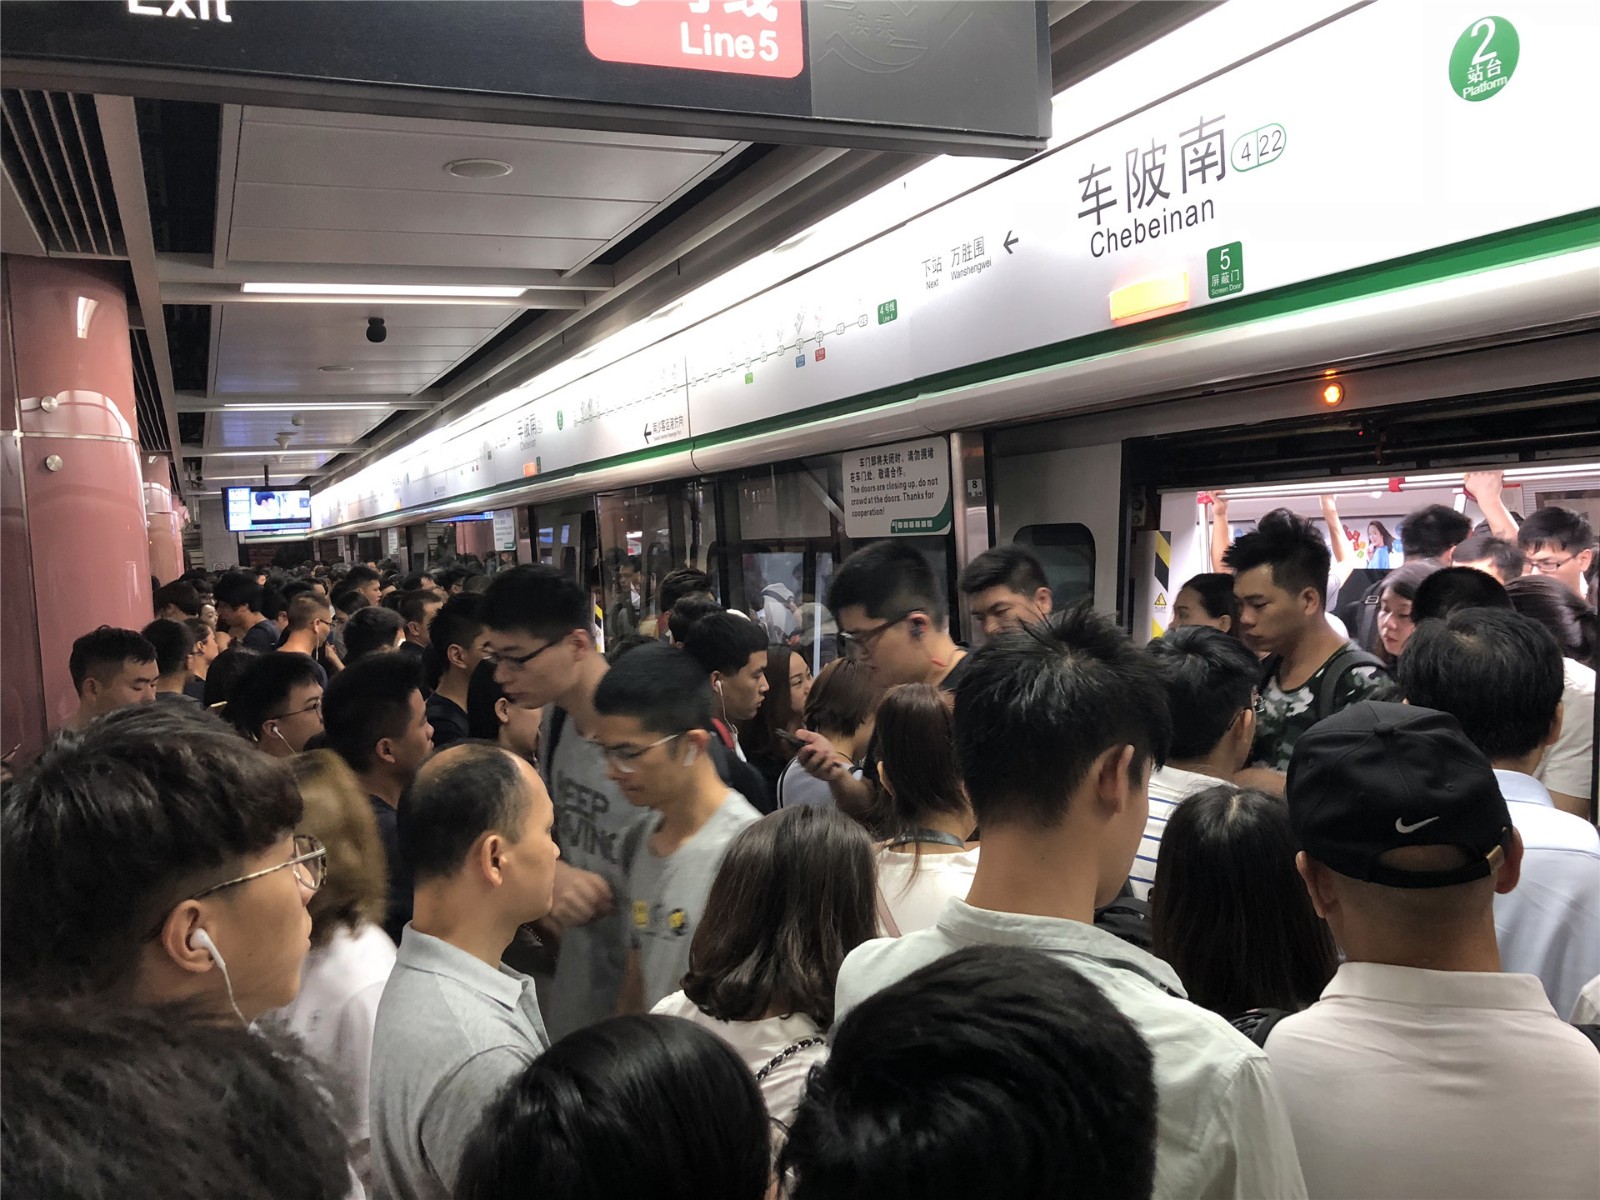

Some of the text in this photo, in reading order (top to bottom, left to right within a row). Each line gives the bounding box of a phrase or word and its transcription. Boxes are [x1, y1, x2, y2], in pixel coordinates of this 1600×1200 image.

[1471, 18, 1498, 65] 2
[1467, 58, 1502, 84] 站台
[1463, 76, 1508, 99] Platform
[1241, 129, 1282, 162] 4 22
[1078, 114, 1226, 226] 车陂南
[1090, 199, 1215, 258] Chebeinan
[921, 236, 985, 278] 下站 万胜围
[1220, 248, 1231, 270] 5
[926, 257, 992, 290] Next Wanshengwei
[1211, 269, 1240, 287] 屏蔽门
[850, 485, 860, 494] The
[861, 484, 876, 493] doors
[886, 481, 907, 490] closing
[918, 477, 926, 487] do
[927, 477, 939, 486] not
[851, 496, 867, 505] crowd
[902, 491, 924, 501] Thanks
[925, 490, 934, 499] for
